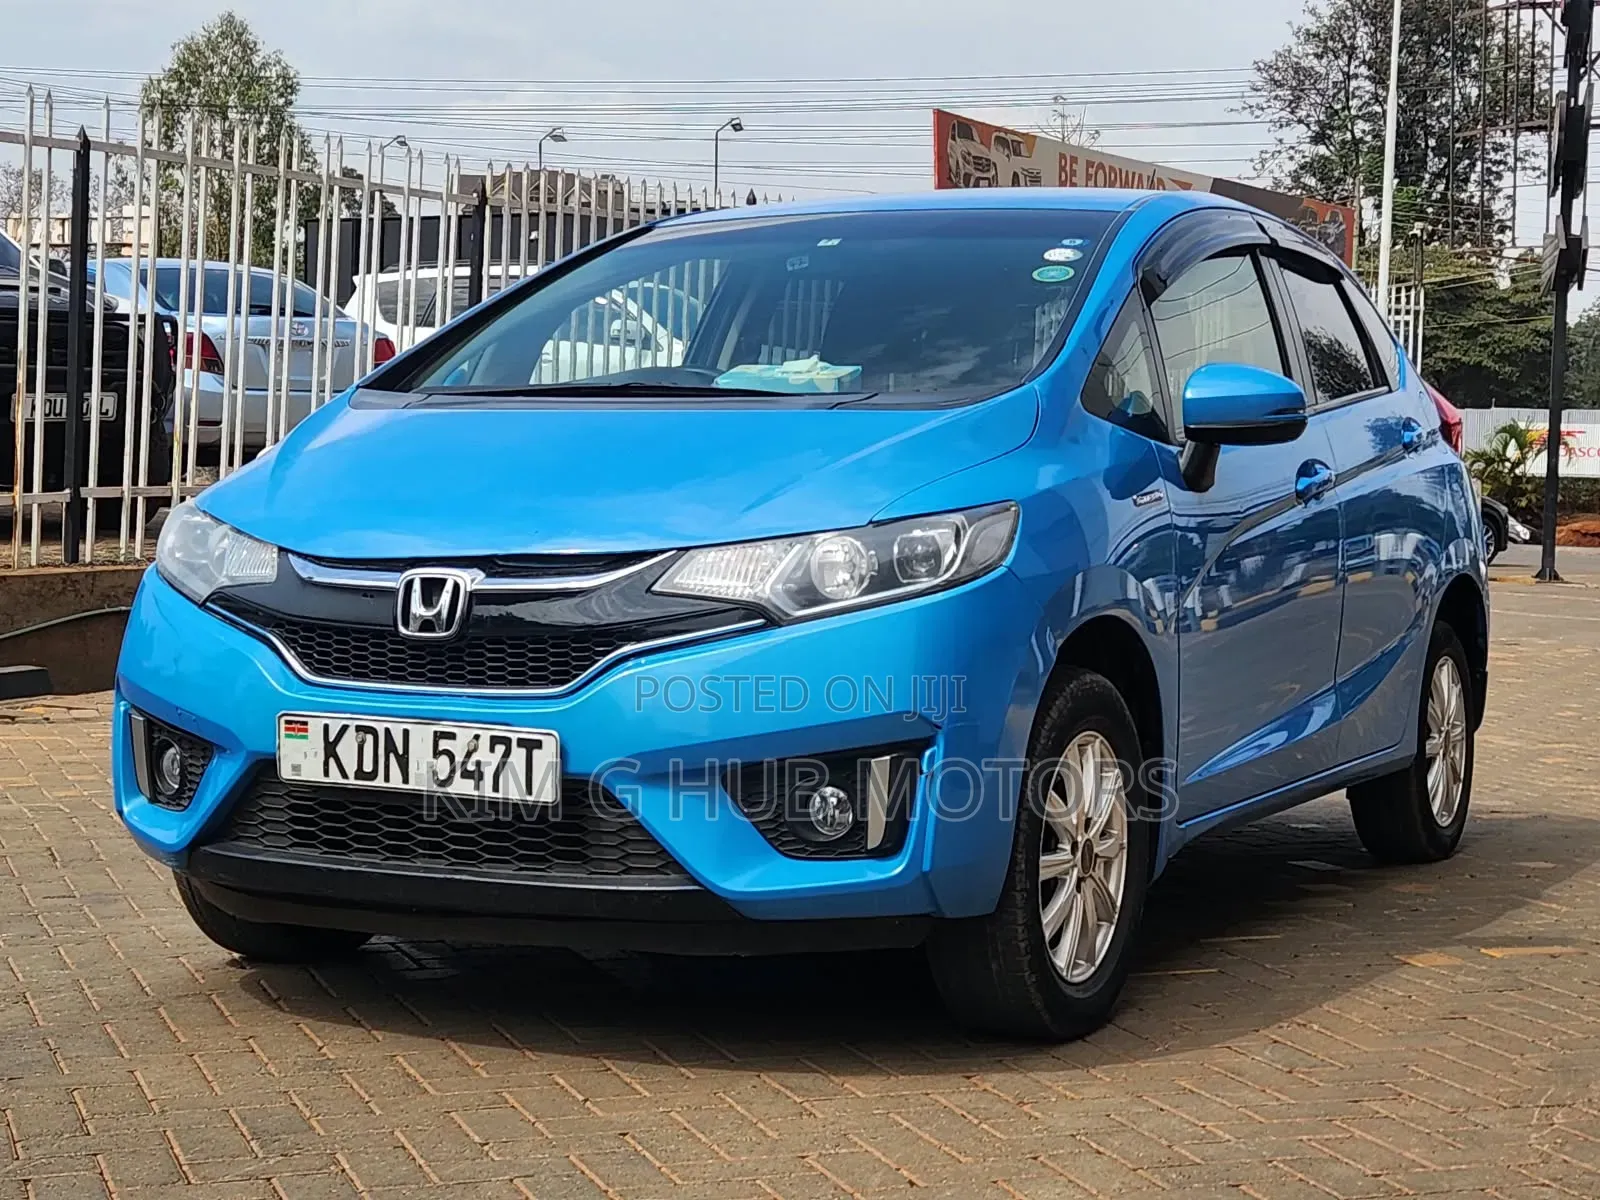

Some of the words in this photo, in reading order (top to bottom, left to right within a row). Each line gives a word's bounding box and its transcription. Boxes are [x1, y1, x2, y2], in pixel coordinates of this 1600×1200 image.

[1058, 152, 1078, 187] BE
[322, 723, 410, 785] KDN
[432, 730, 543, 796] 547T
